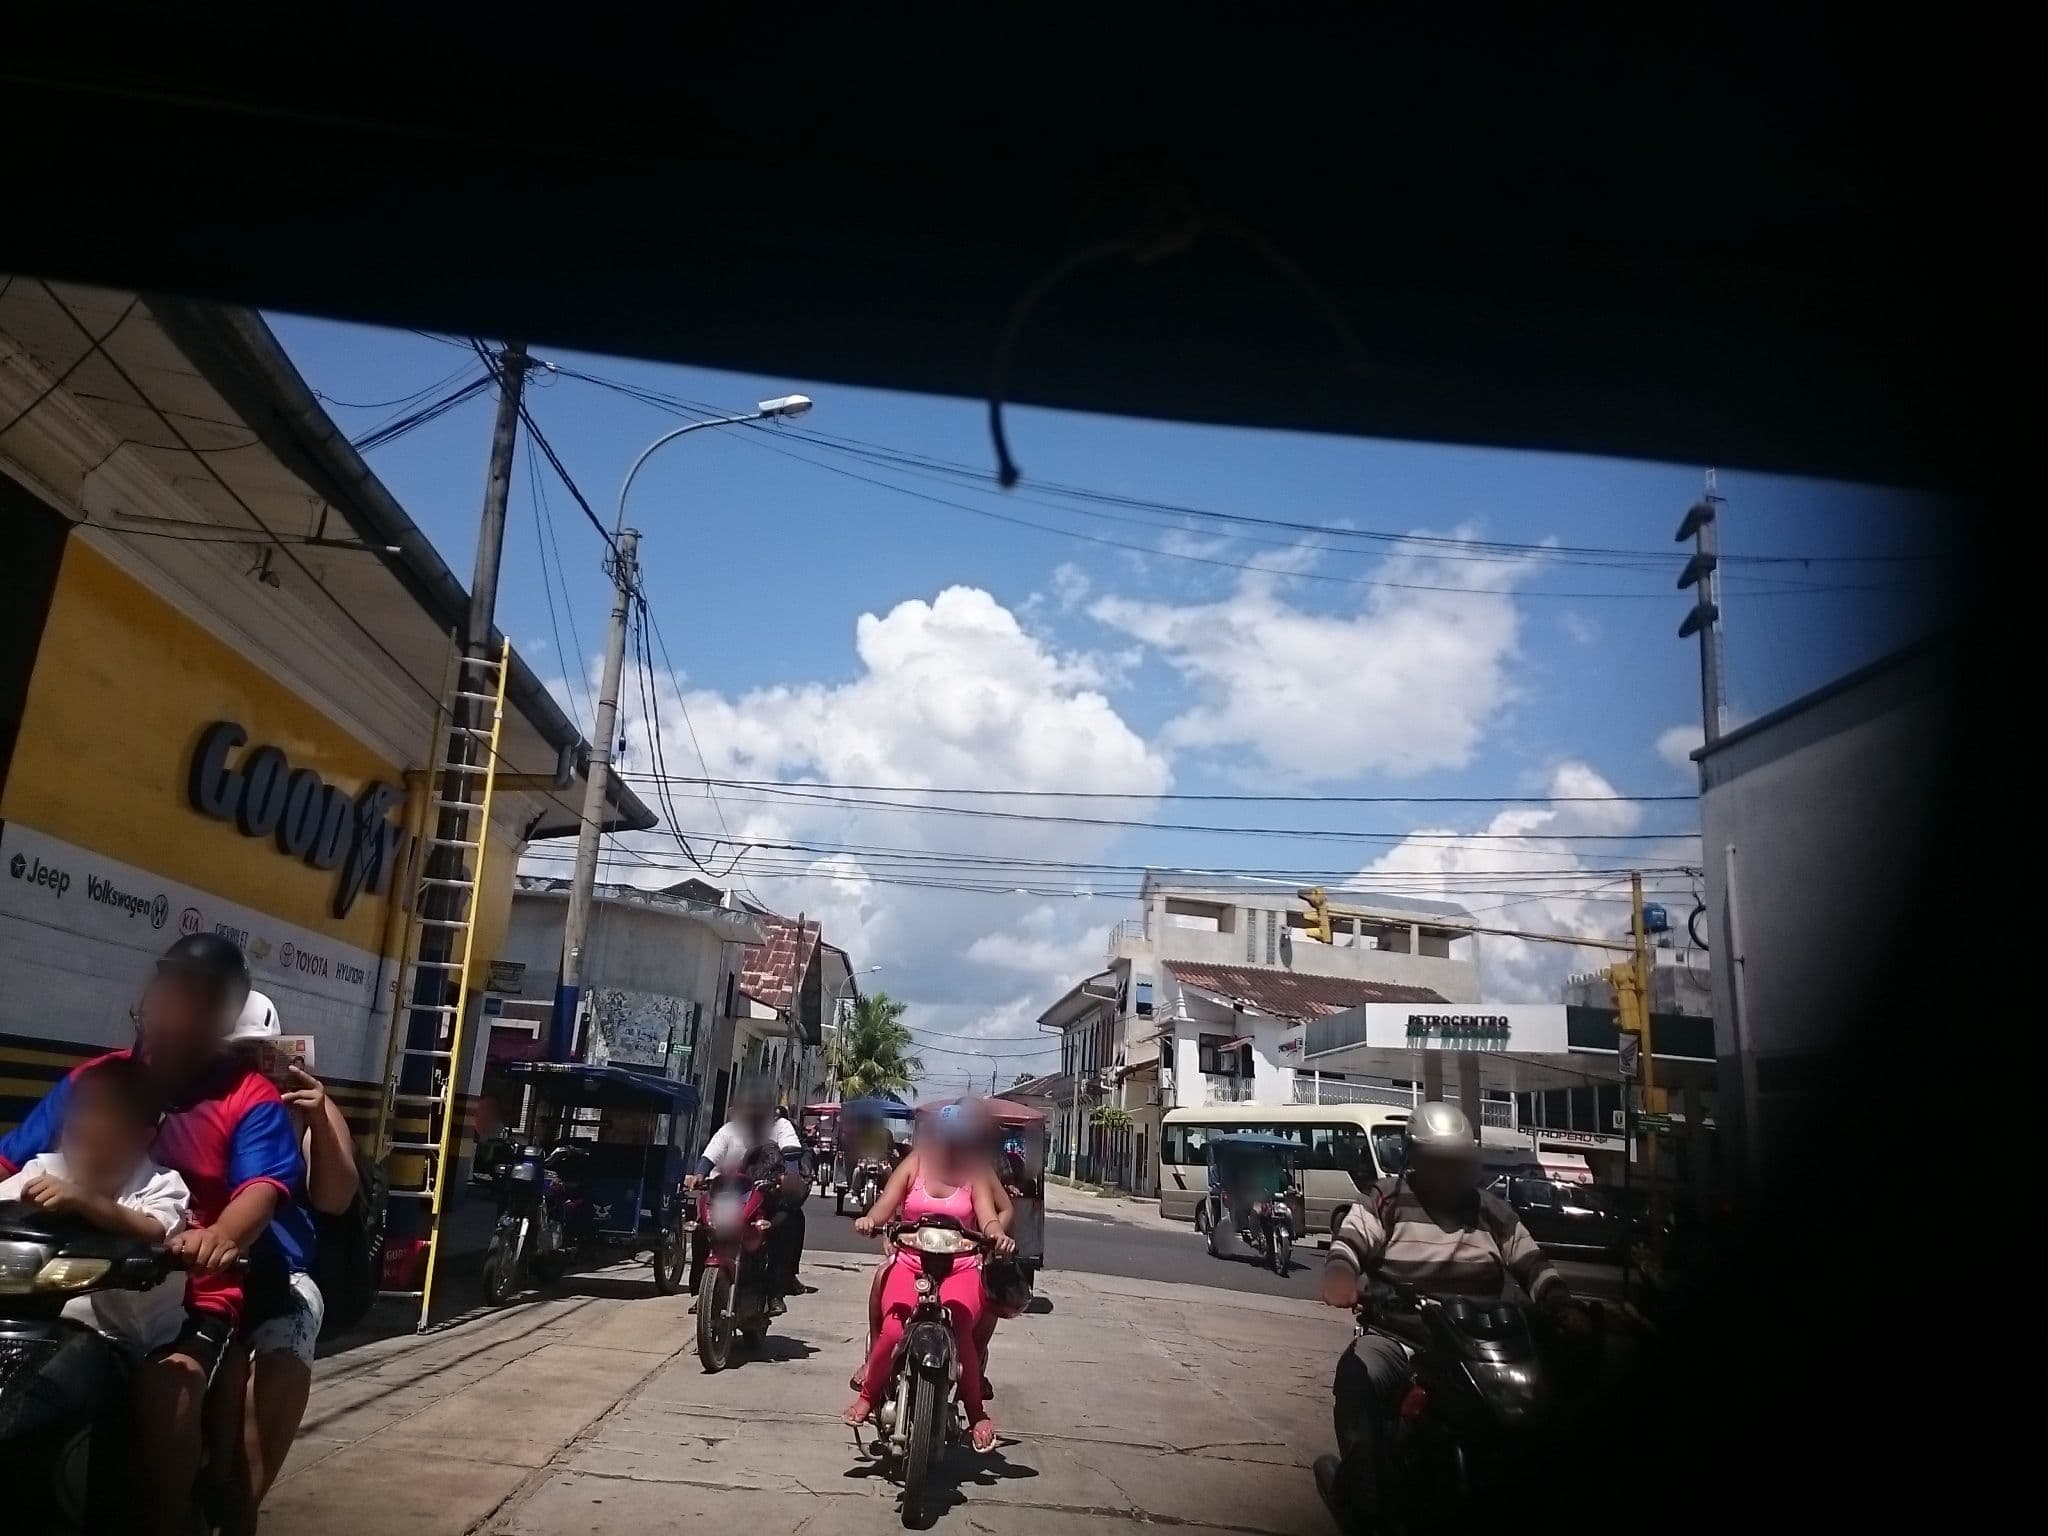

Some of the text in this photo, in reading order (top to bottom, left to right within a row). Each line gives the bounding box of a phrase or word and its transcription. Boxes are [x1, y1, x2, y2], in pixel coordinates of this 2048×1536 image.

[27, 857, 70, 899] Jeep
[88, 873, 152, 919] Volkswagen
[181, 911, 200, 935] KIA
[294, 949, 329, 979] TOYOTA
[335, 961, 366, 985] HYUNDAI
[1407, 1014, 1510, 1027] PETROCENTRO
